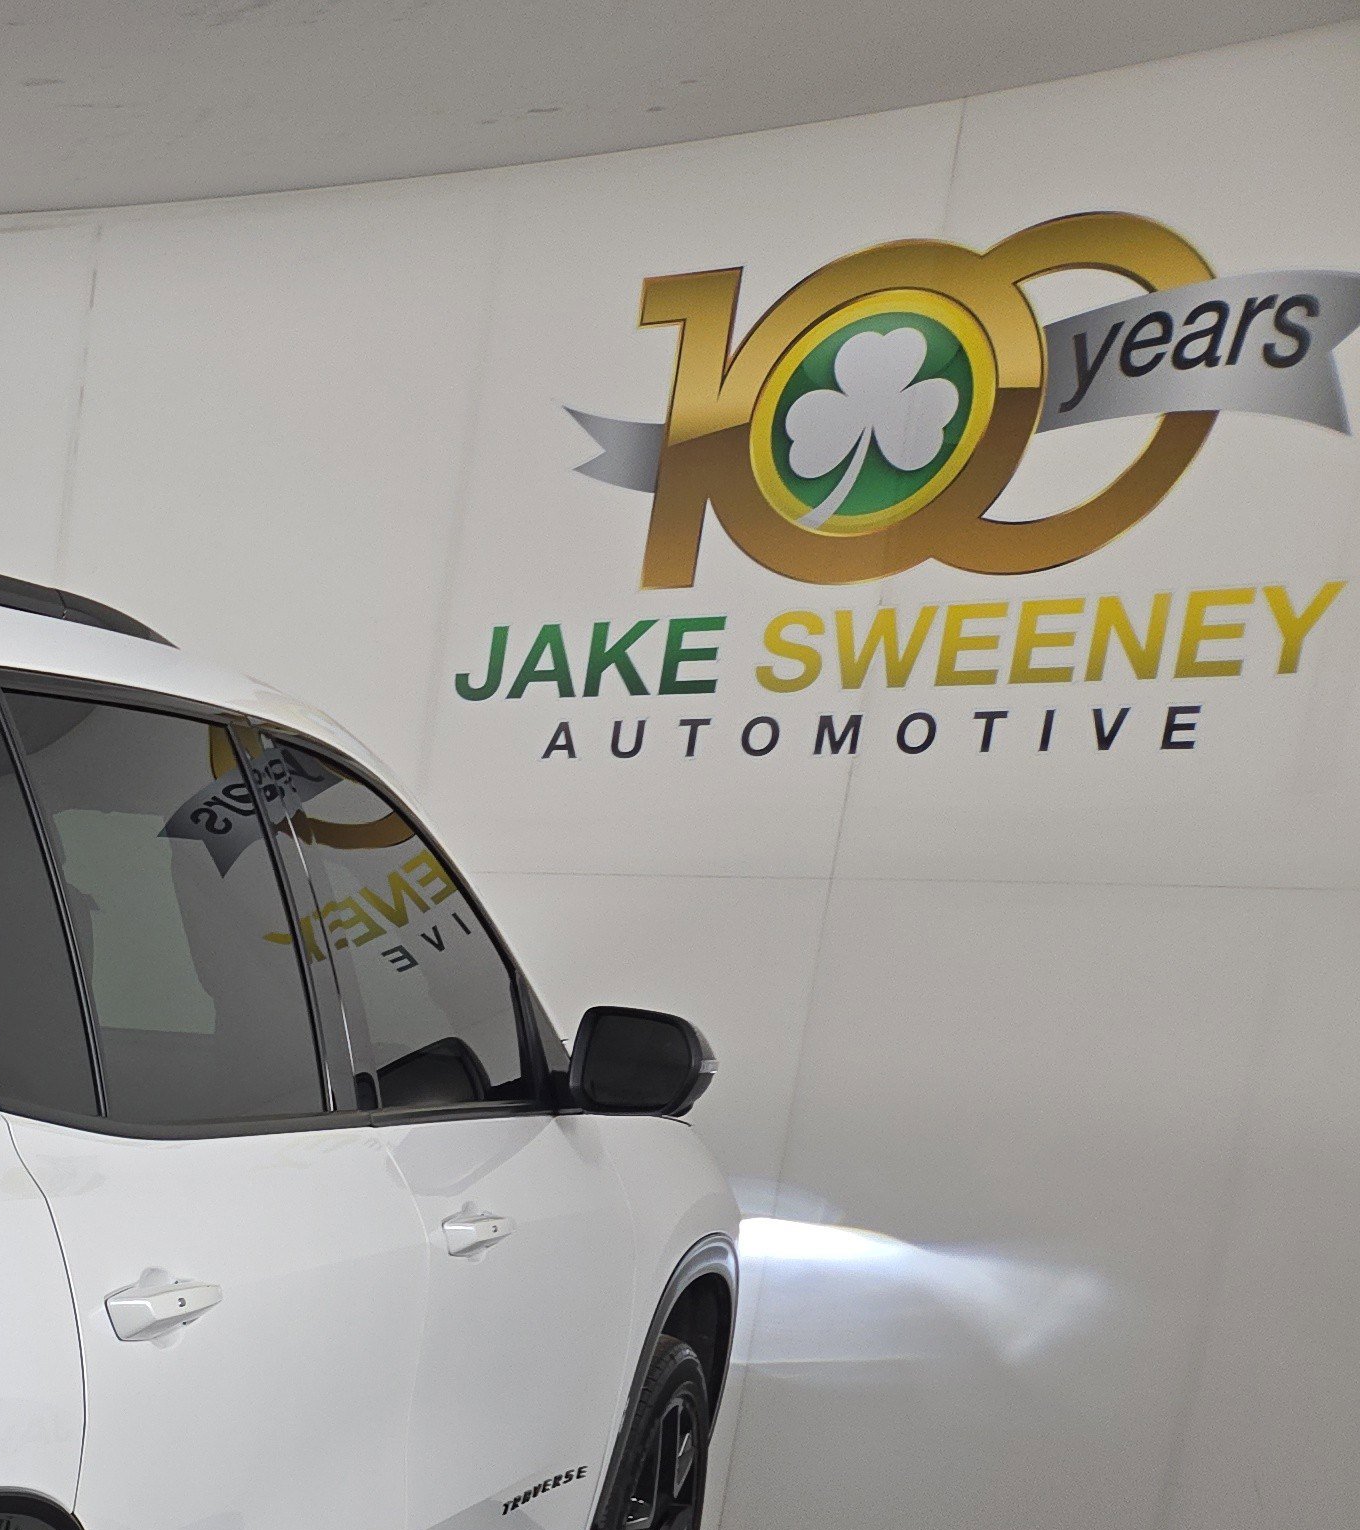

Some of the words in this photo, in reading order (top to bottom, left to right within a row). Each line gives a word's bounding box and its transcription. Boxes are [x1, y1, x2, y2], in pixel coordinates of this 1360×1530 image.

[1059, 290, 1321, 413] years
[454, 614, 728, 702] JAKE
[754, 579, 1350, 695] SWEENEY
[541, 705, 1204, 760] AUTOMOTIVE
[501, 1465, 589, 1516] TRAVERSE
